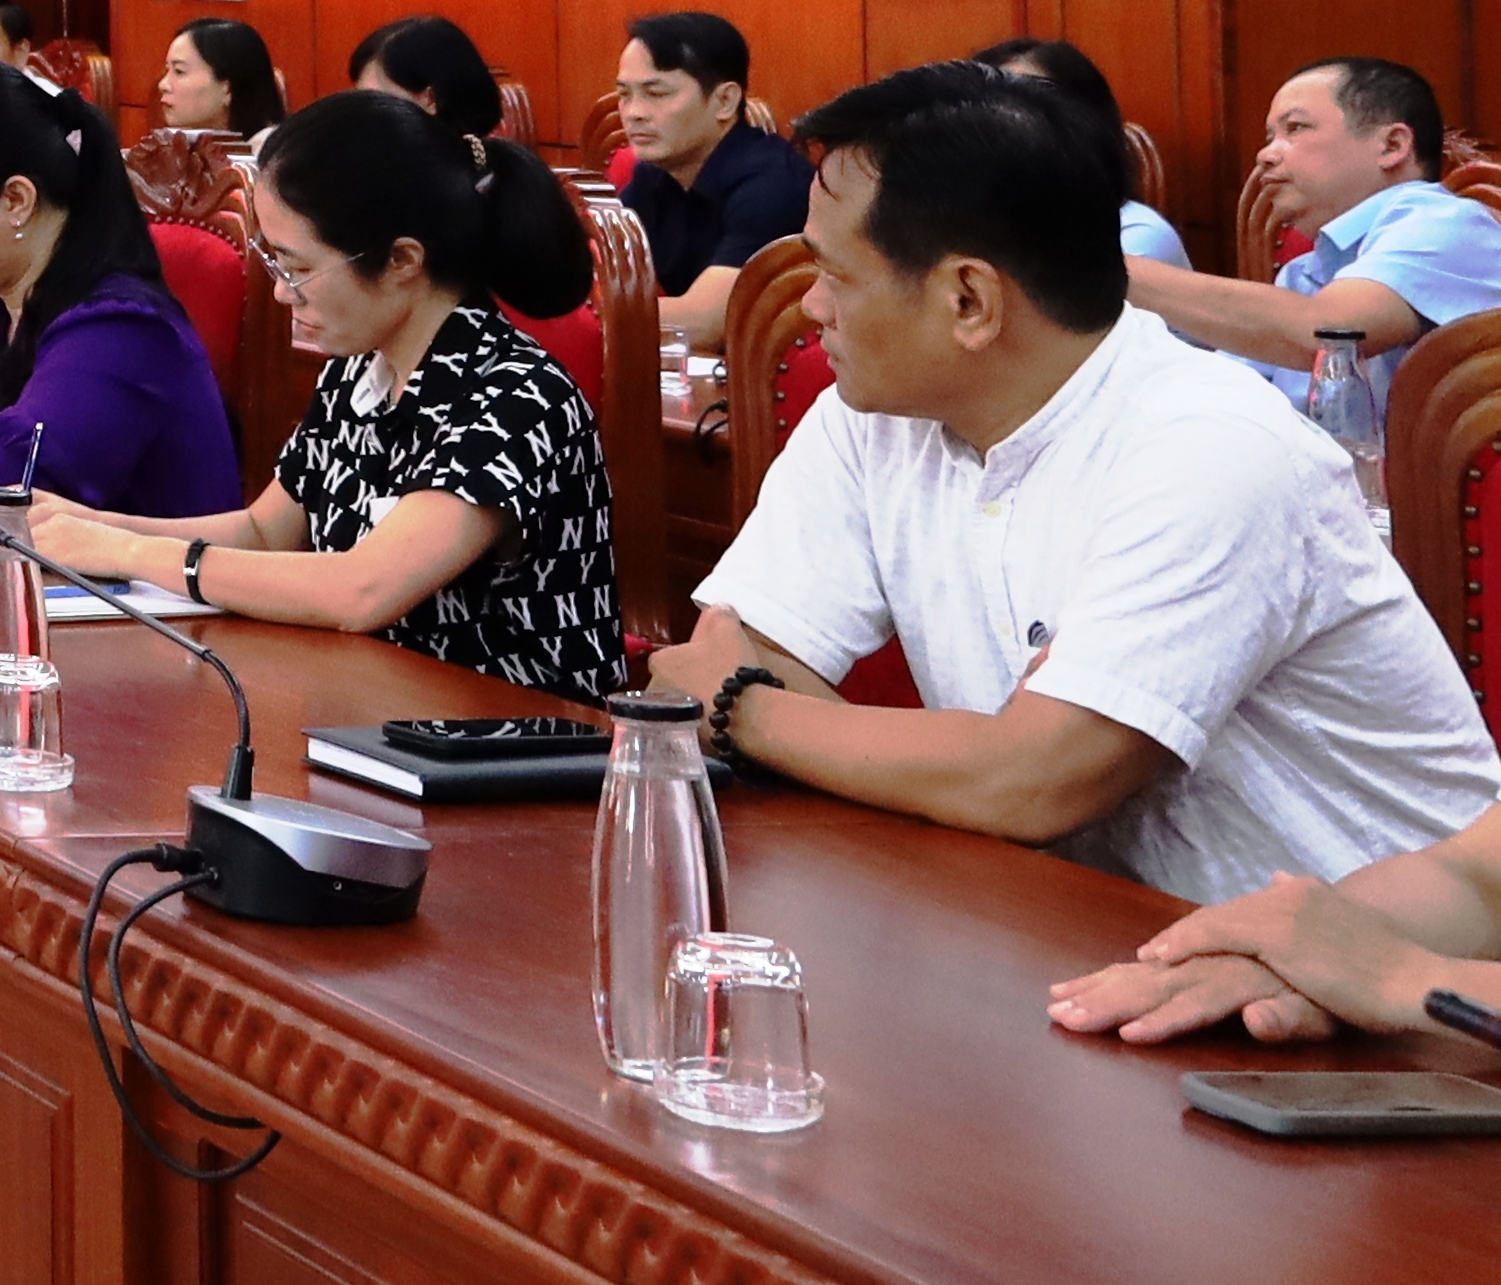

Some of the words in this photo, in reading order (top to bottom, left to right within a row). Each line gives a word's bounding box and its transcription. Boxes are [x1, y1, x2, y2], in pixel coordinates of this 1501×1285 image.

[321, 389, 339, 422] Y
[305, 437, 329, 471] N
[524, 420, 554, 467] N
[558, 516, 584, 551] N
[533, 559, 557, 592] Y
[580, 551, 597, 585] Y
[553, 592, 581, 629] N
[593, 584, 612, 620] N
[539, 635, 562, 667] Y
